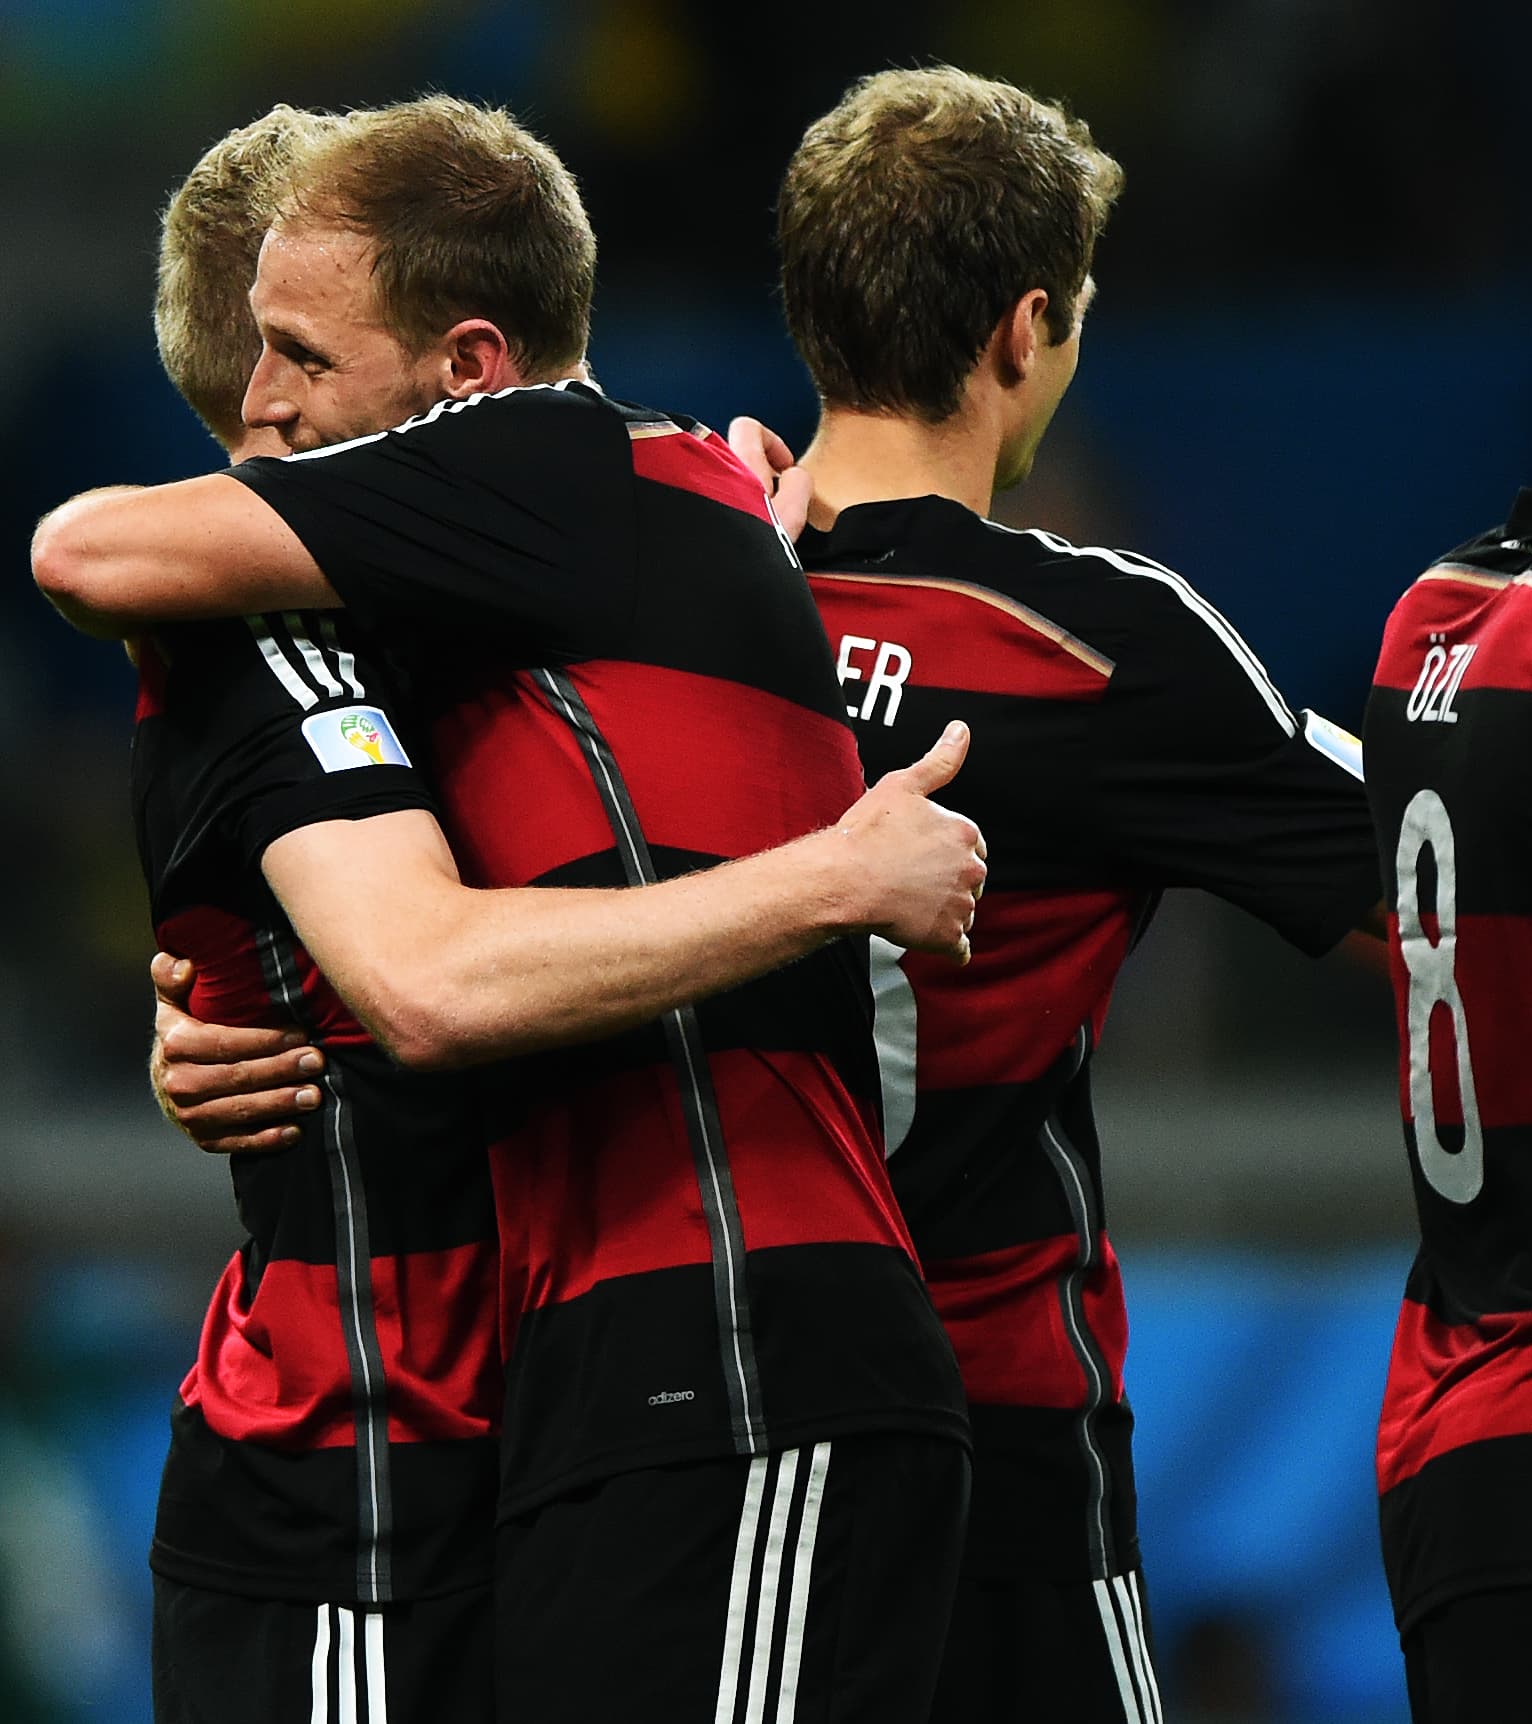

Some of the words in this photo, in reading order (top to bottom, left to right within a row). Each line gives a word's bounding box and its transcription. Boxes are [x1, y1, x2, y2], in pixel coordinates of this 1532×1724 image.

[1407, 632, 1478, 723] ÖZIL
[1396, 789, 1484, 1204] 8
[648, 1391, 695, 1406] adizero
